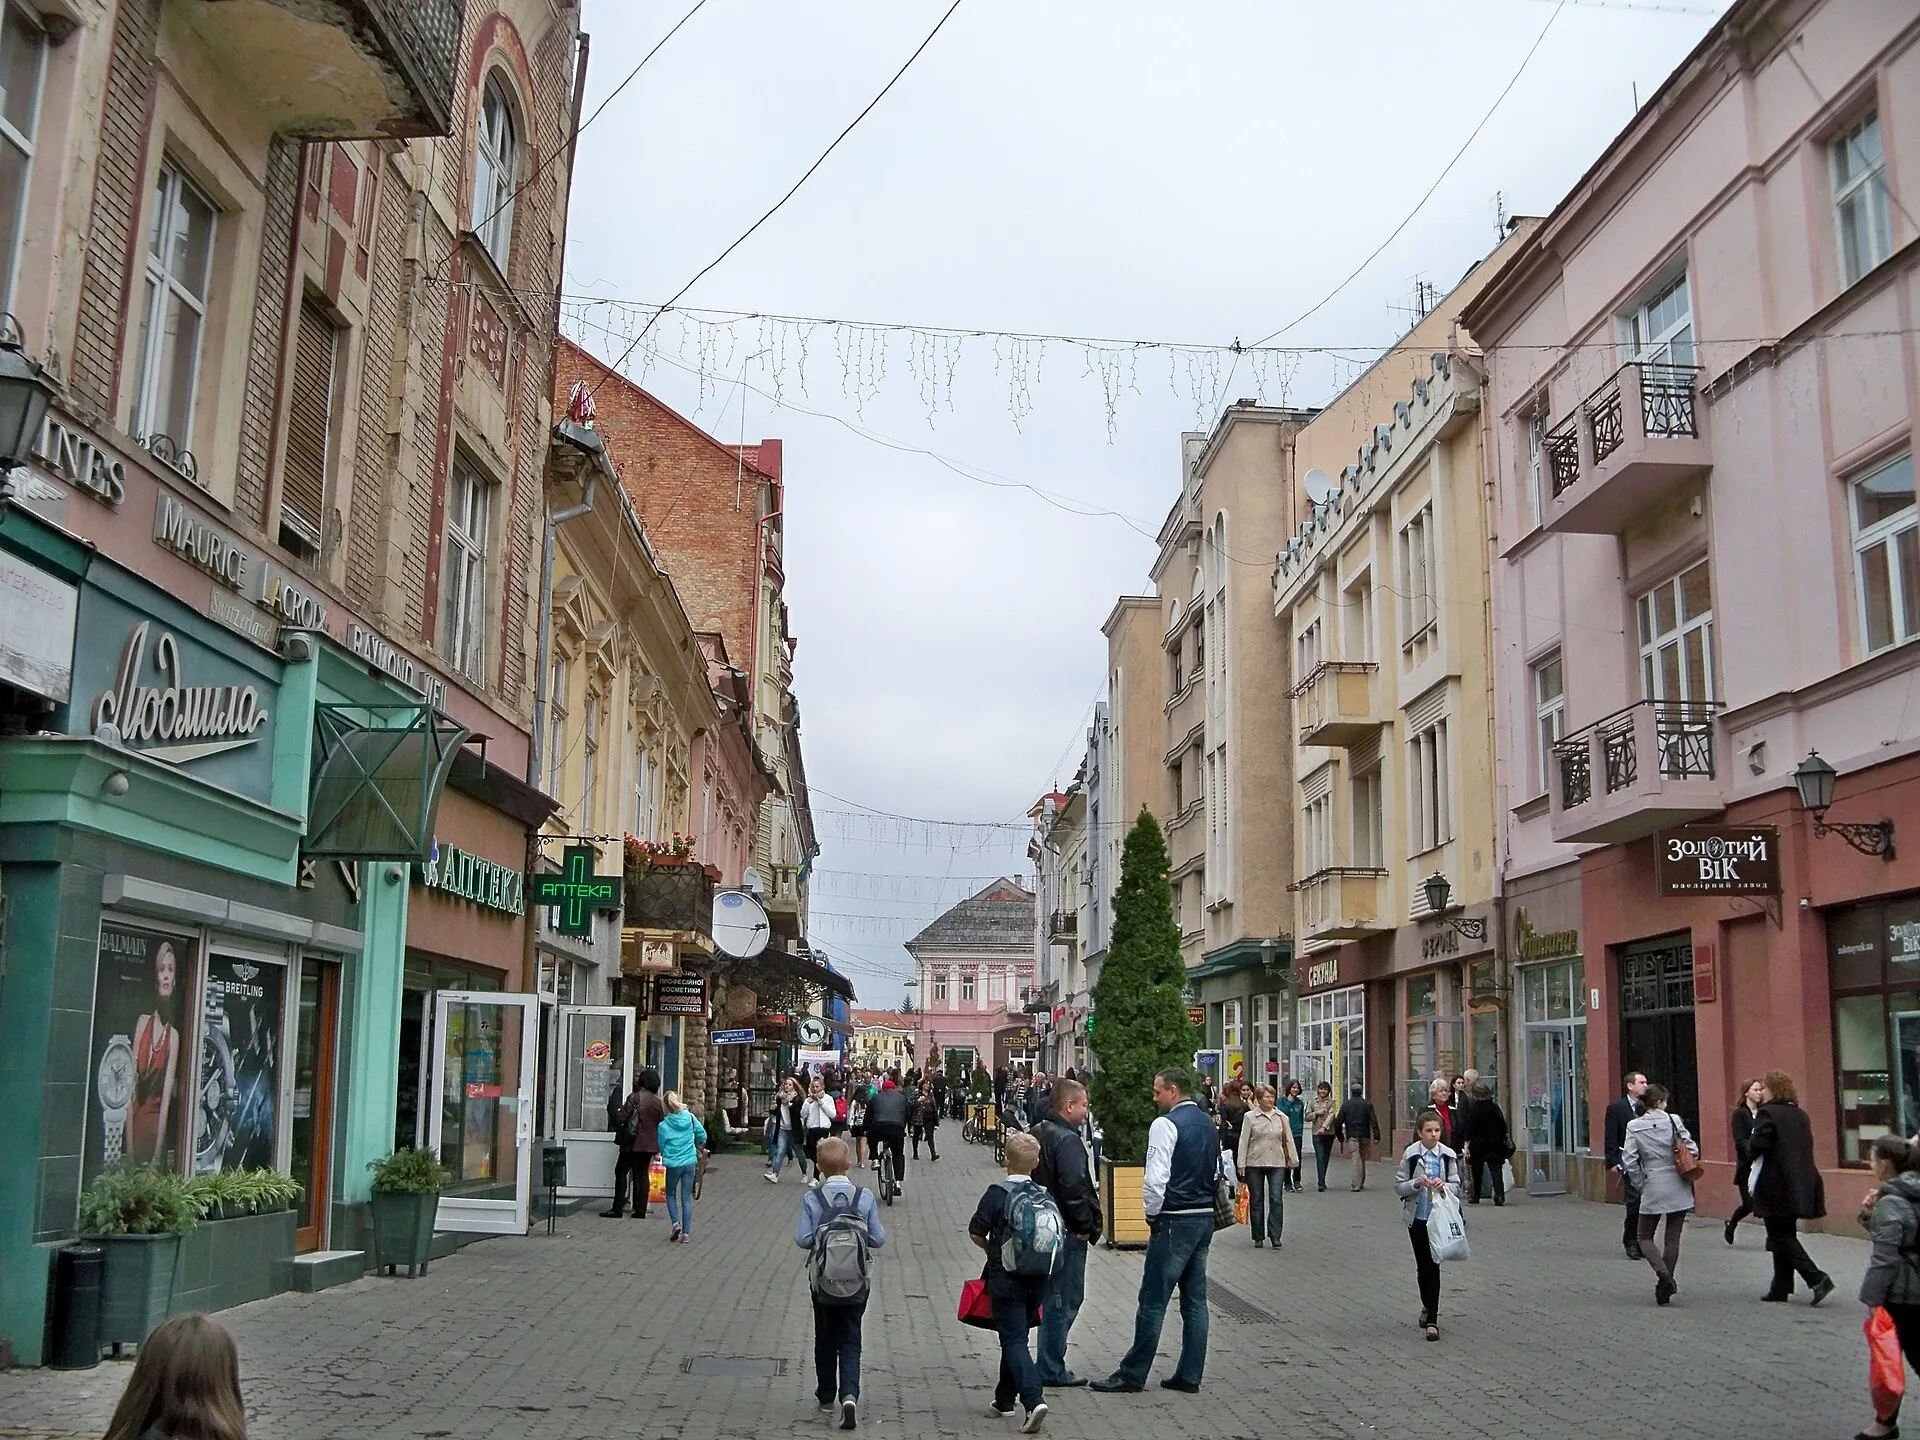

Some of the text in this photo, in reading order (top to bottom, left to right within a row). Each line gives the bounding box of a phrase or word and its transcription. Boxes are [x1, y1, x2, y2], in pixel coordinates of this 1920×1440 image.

[156, 496, 327, 629] MAURICE LACROIX
[95, 621, 268, 740] Людмила
[442, 842, 525, 916] АПТЕКА
[542, 883, 612, 898] АПТЕКА
[101, 932, 147, 956] BALMAIN
[1309, 960, 1338, 987] СЕКУНДА
[226, 981, 264, 997] BREITLING
[661, 986, 701, 994] КОСМЕТИКИ
